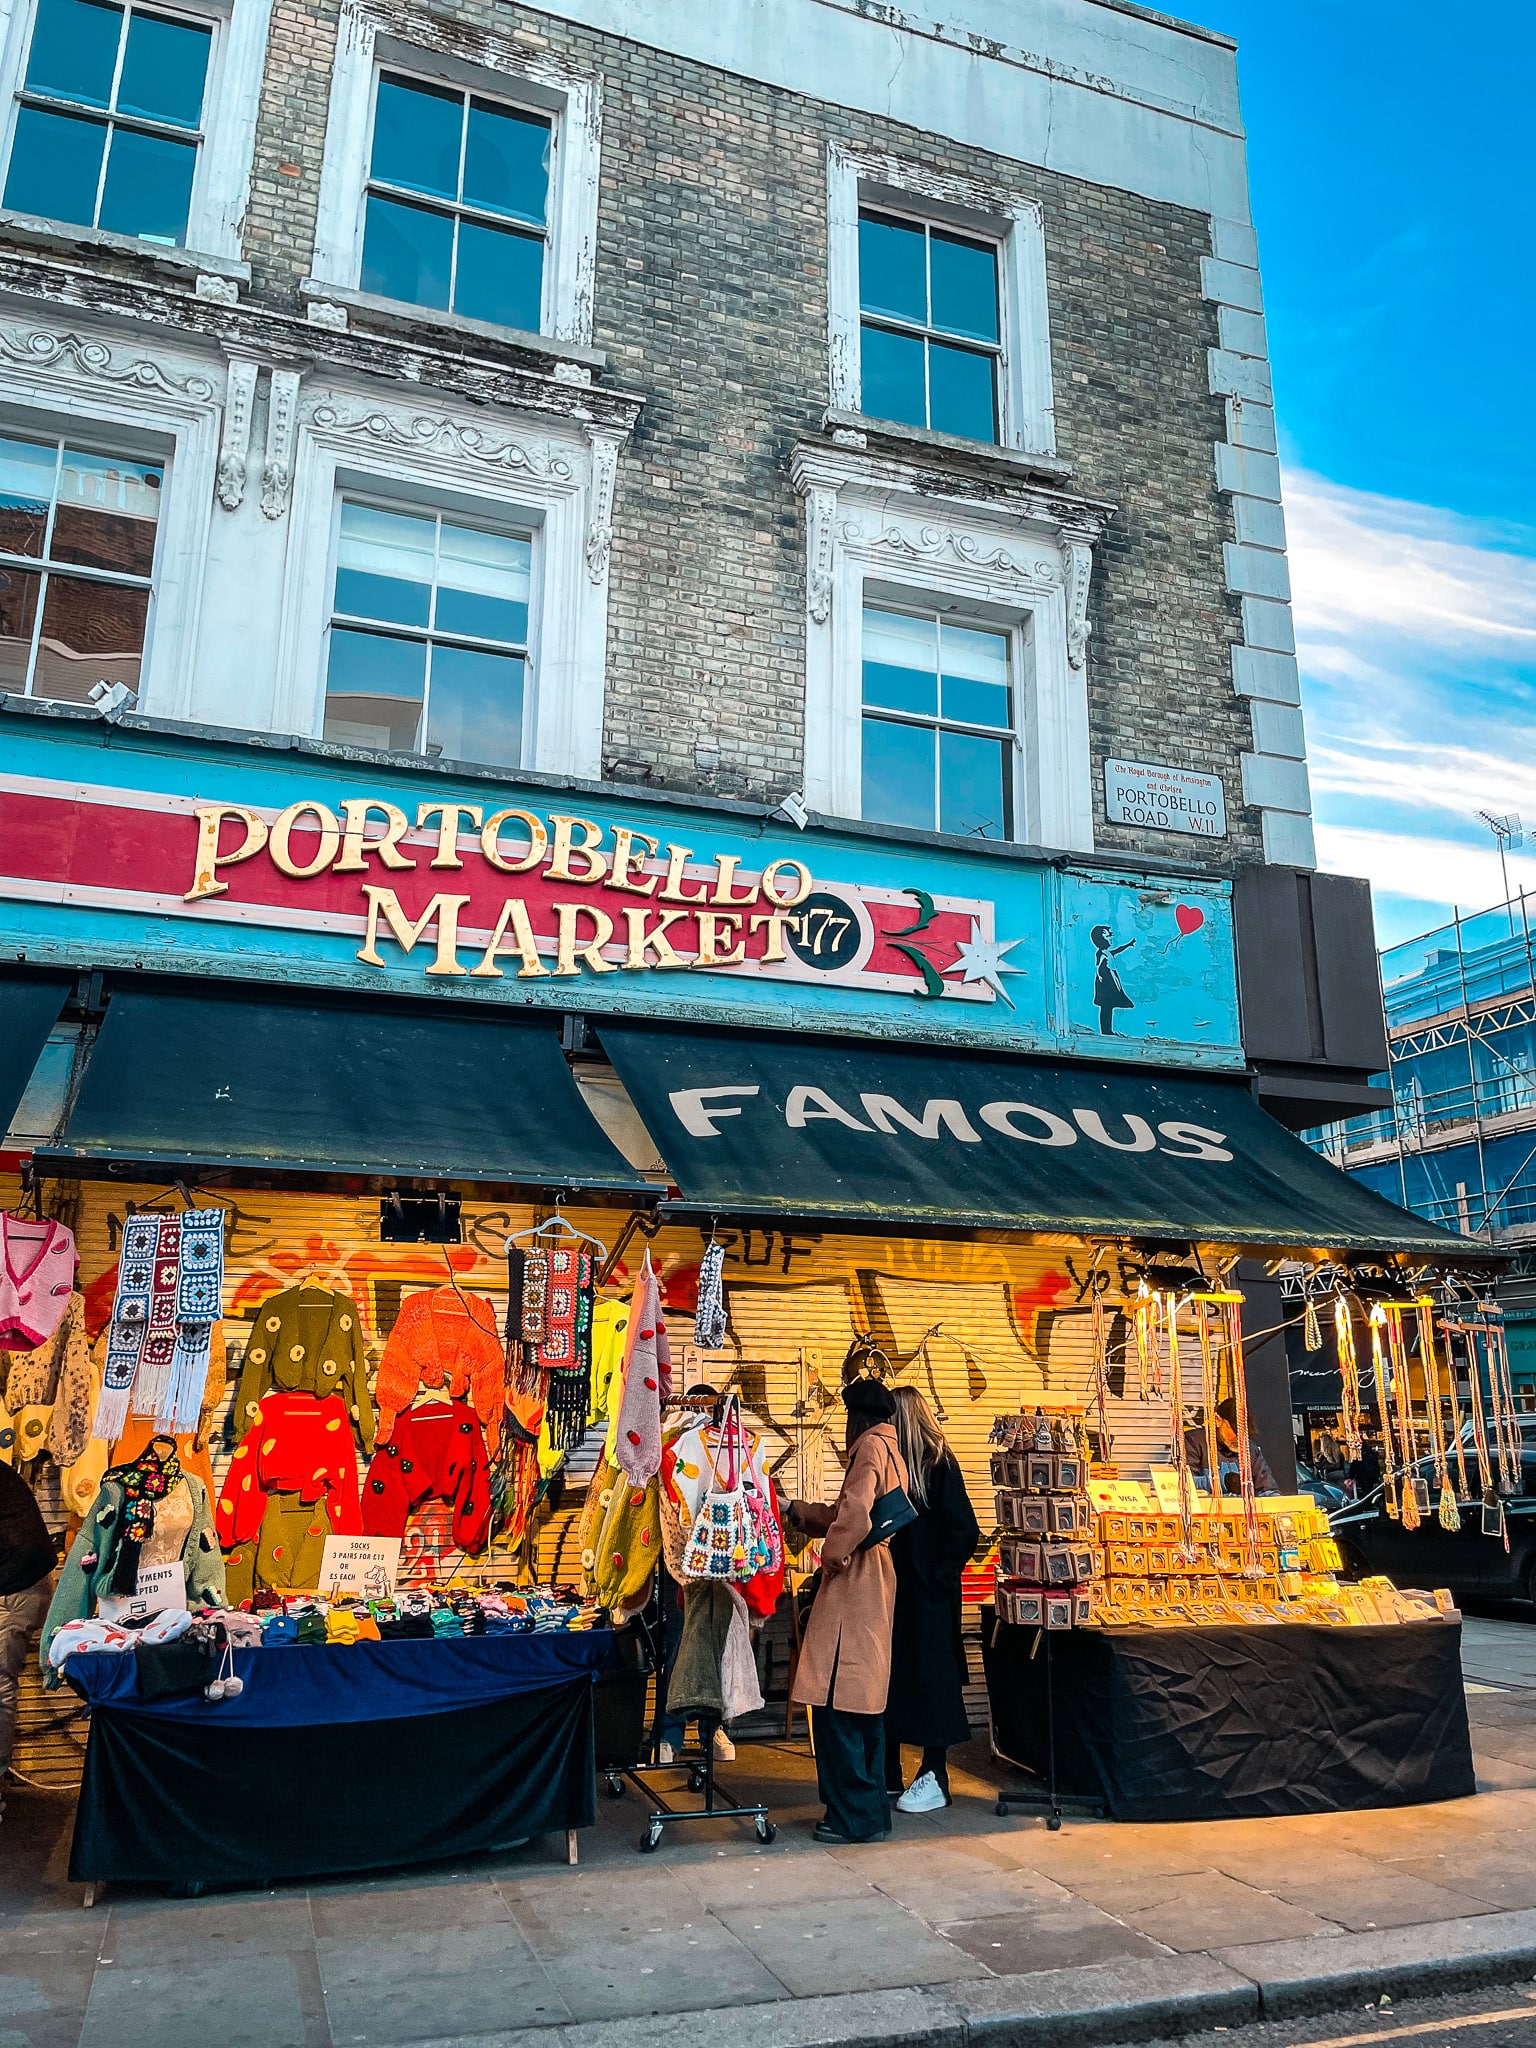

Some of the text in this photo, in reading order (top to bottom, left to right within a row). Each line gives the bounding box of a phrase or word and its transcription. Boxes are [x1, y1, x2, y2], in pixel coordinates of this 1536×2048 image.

[1115, 765, 1126, 773] The
[1128, 766, 1144, 778] Royal
[1147, 769, 1170, 781] Borough
[1181, 774, 1212, 787] Kensington
[1147, 782, 1182, 794] and Chelsea
[1117, 787, 1217, 815] PORTOBELLO
[183, 798, 813, 909] PORTOBELLO
[355, 883, 800, 978] MARKET
[797, 908, 851, 956] 177
[669, 1086, 1234, 1162] FAMOUS
[338, 1552, 358, 1560] PAIRS
[350, 1542, 370, 1550] SOCKS
[137, 1569, 173, 1584] YMENTS
[340, 1573, 356, 1581] EACH
